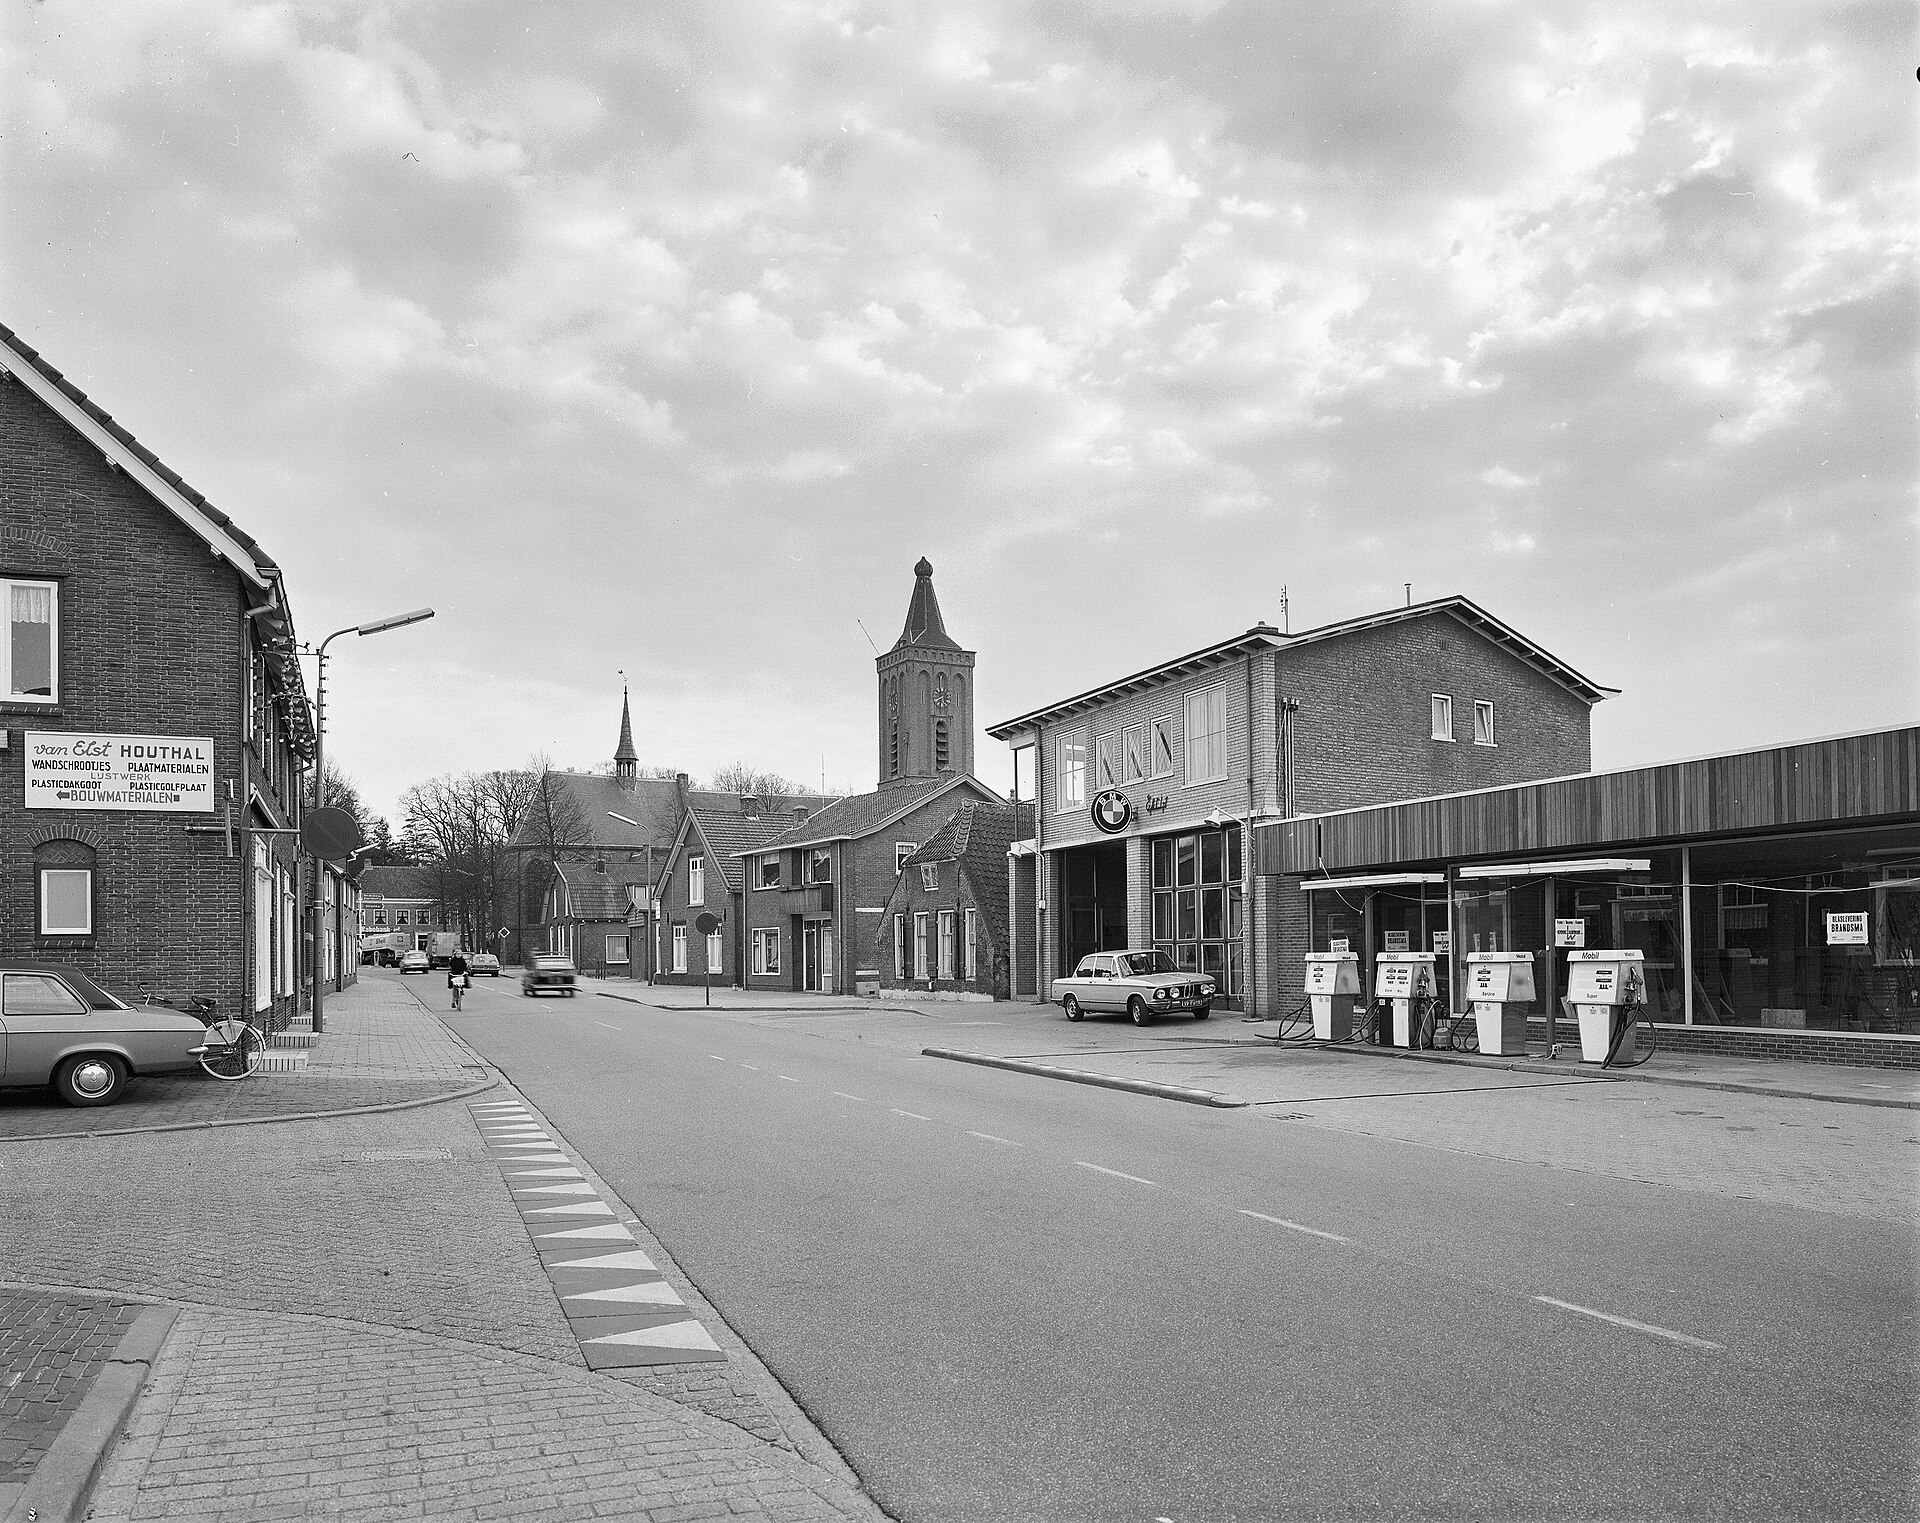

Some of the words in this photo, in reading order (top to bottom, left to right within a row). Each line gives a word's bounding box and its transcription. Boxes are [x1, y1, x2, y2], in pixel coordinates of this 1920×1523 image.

[33, 744, 68, 756] van
[72, 740, 112, 757] Elst
[120, 745, 205, 760] HOUTHAL
[31, 759, 111, 771] WANDSCHROOTJES
[127, 762, 209, 774] PLAATMATERIALEN
[31, 779, 103, 790] PLASTICDAKGOOT
[129, 782, 207, 792] PLASTICGOLFPLAAT
[70, 790, 173, 804] BOUWMATERIALEN
[1099, 792, 1128, 806] BMW
[1831, 923, 1863, 932] BRANDSMA
[1581, 952, 1600, 960] Mobil
